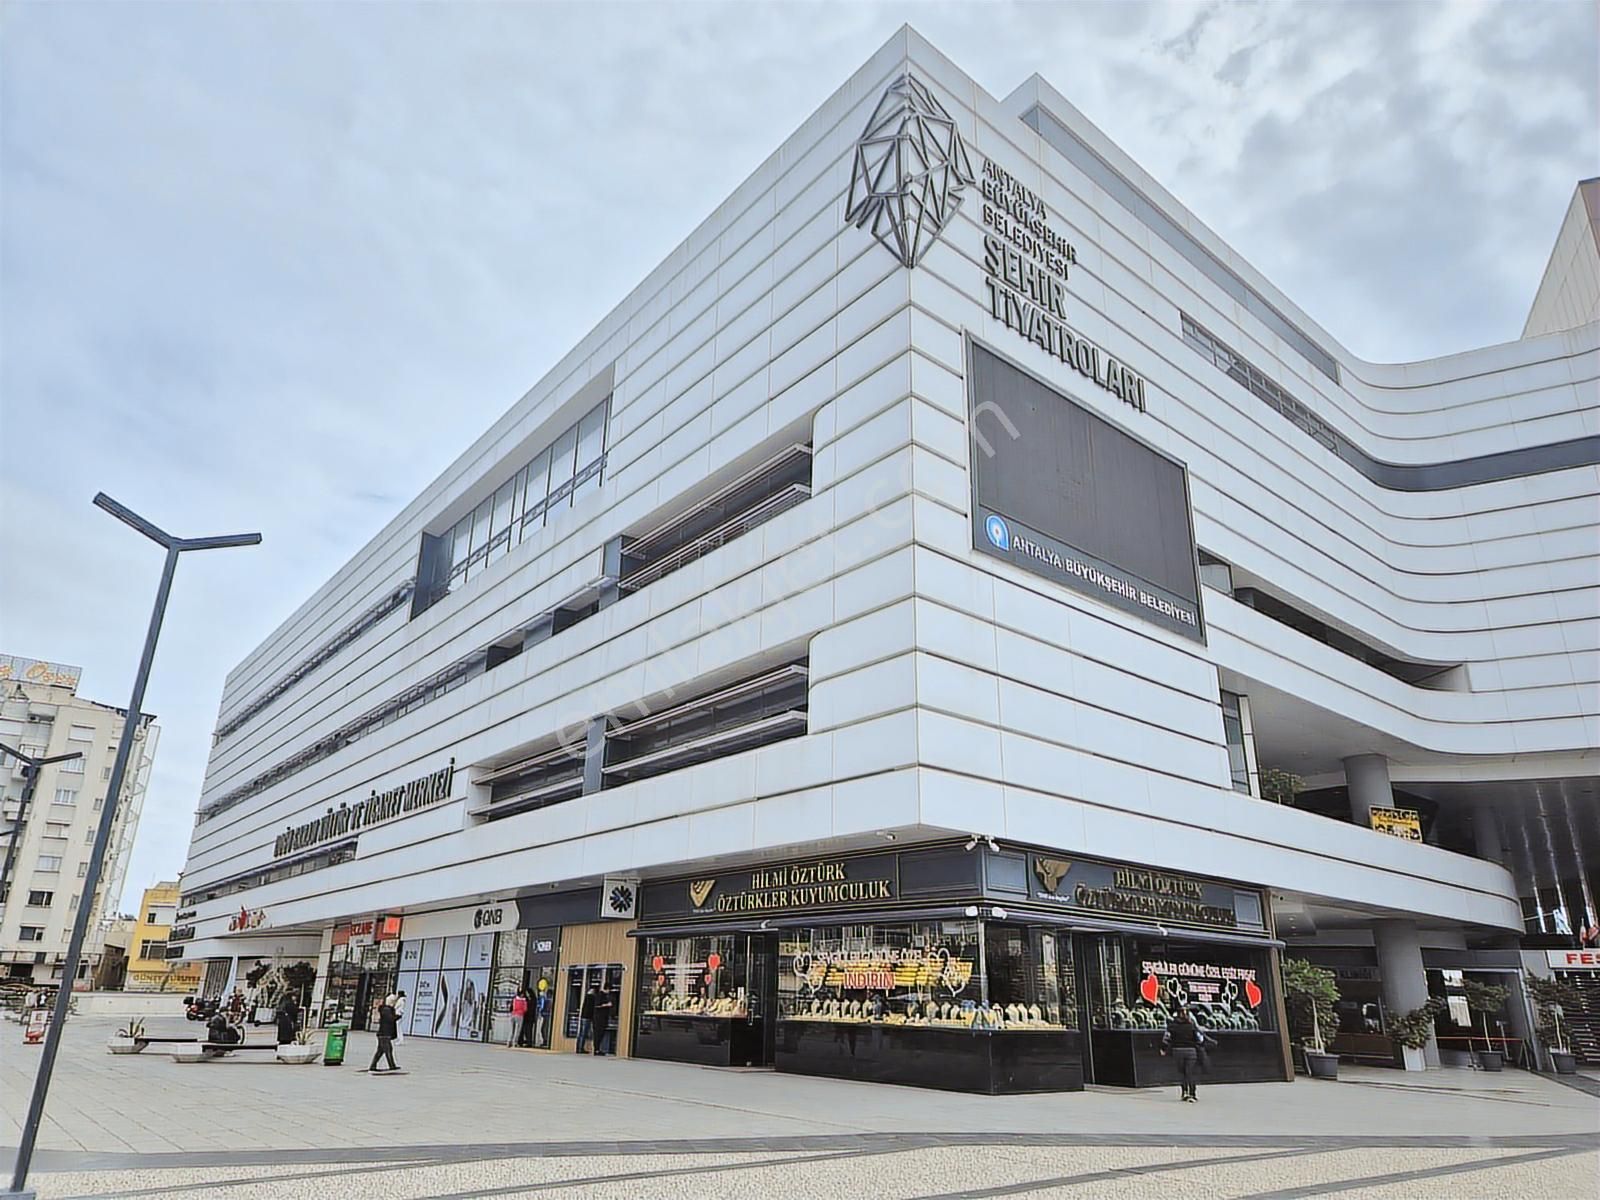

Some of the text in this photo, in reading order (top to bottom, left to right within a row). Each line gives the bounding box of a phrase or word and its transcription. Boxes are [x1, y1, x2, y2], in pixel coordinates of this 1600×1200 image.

[983, 157, 1047, 220] ANTALYA
[986, 275, 1146, 414] TİYATROLARI
[1012, 535, 1062, 569] ANTALYA
[1065, 558, 1138, 601] BÜYÜKŞEHİR
[717, 879, 891, 912] ÖZTÜRKLER KUYUMCULUK
[752, 862, 846, 890] HİLMİ ÖZTÜRK
[483, 908, 503, 926] QNB
